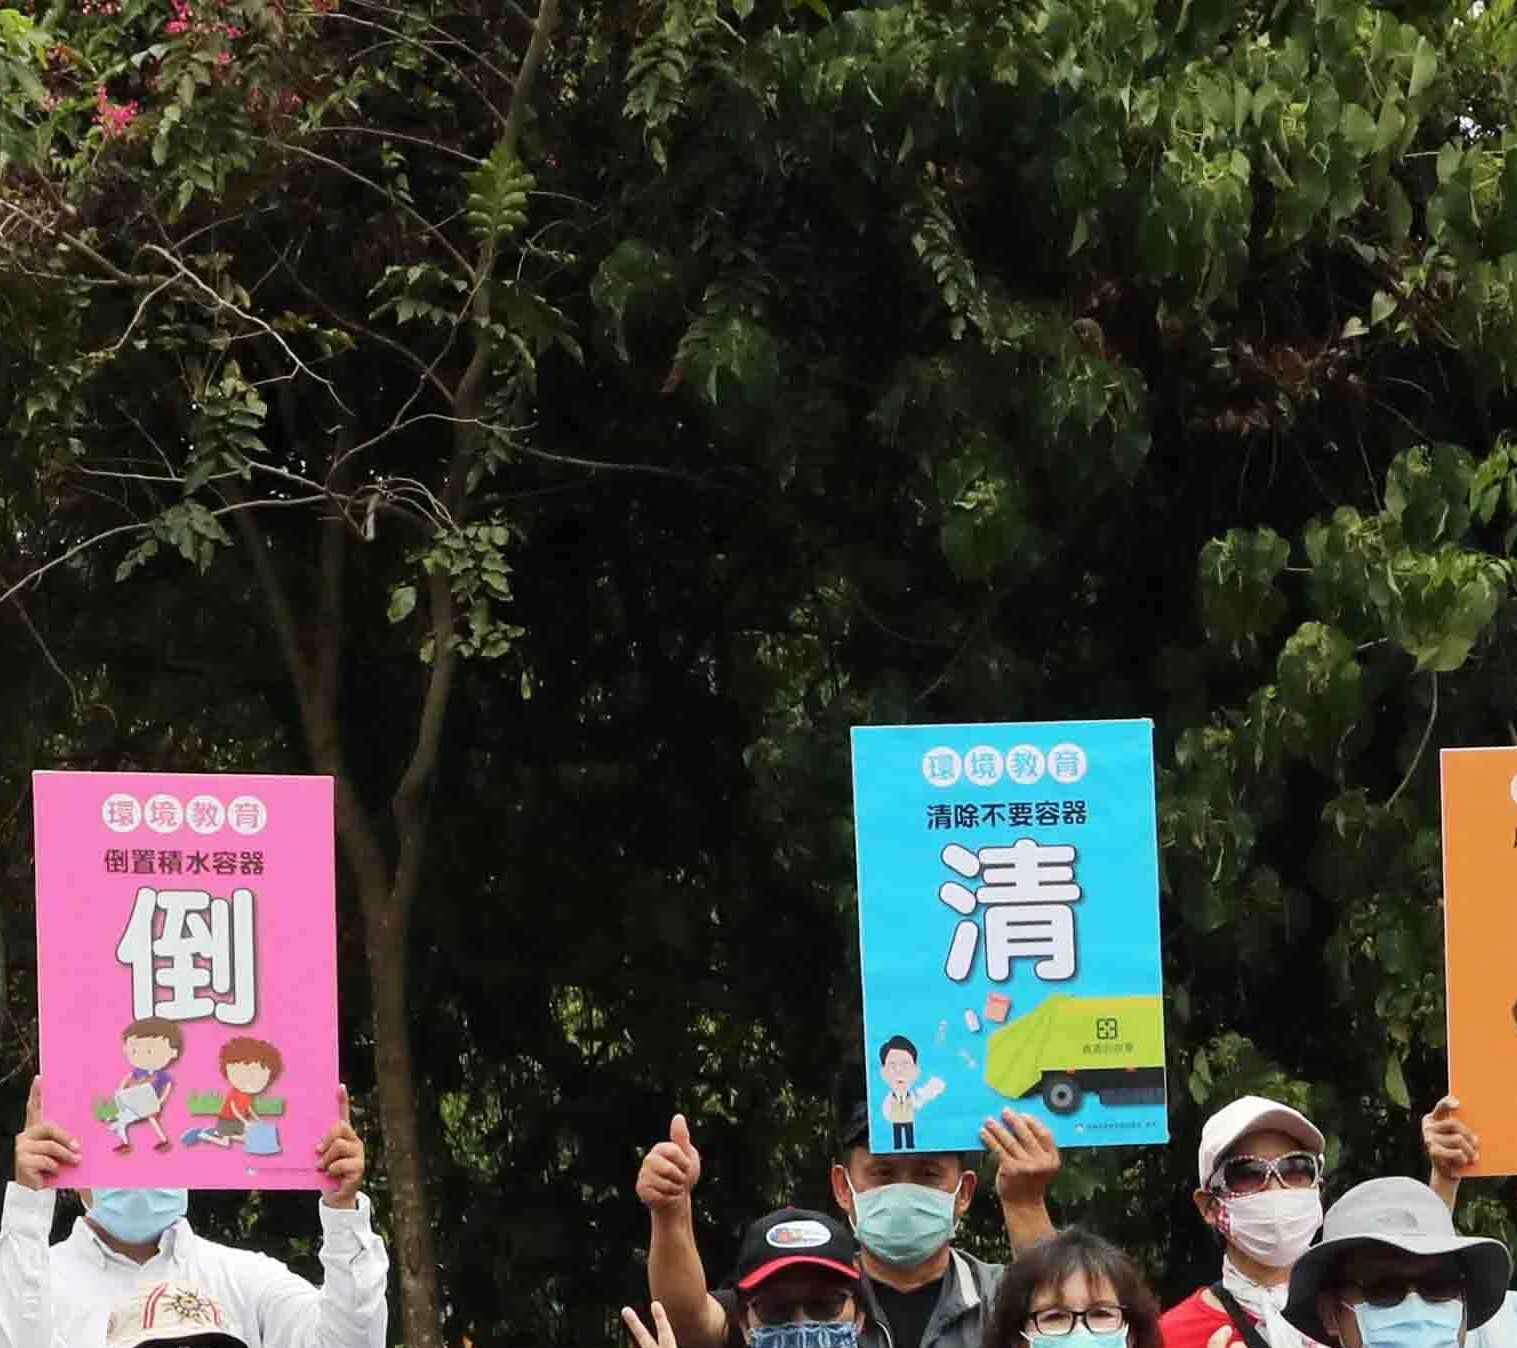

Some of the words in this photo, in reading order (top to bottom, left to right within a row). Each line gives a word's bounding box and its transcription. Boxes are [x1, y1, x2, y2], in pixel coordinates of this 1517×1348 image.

[924, 746, 1085, 785] 環境教育
[103, 795, 266, 832] 環境教育
[926, 801, 1087, 830] 清除不要容器
[103, 849, 265, 875] 倒置積水容器
[939, 838, 1082, 982] 清
[115, 886, 257, 1024] 倒
